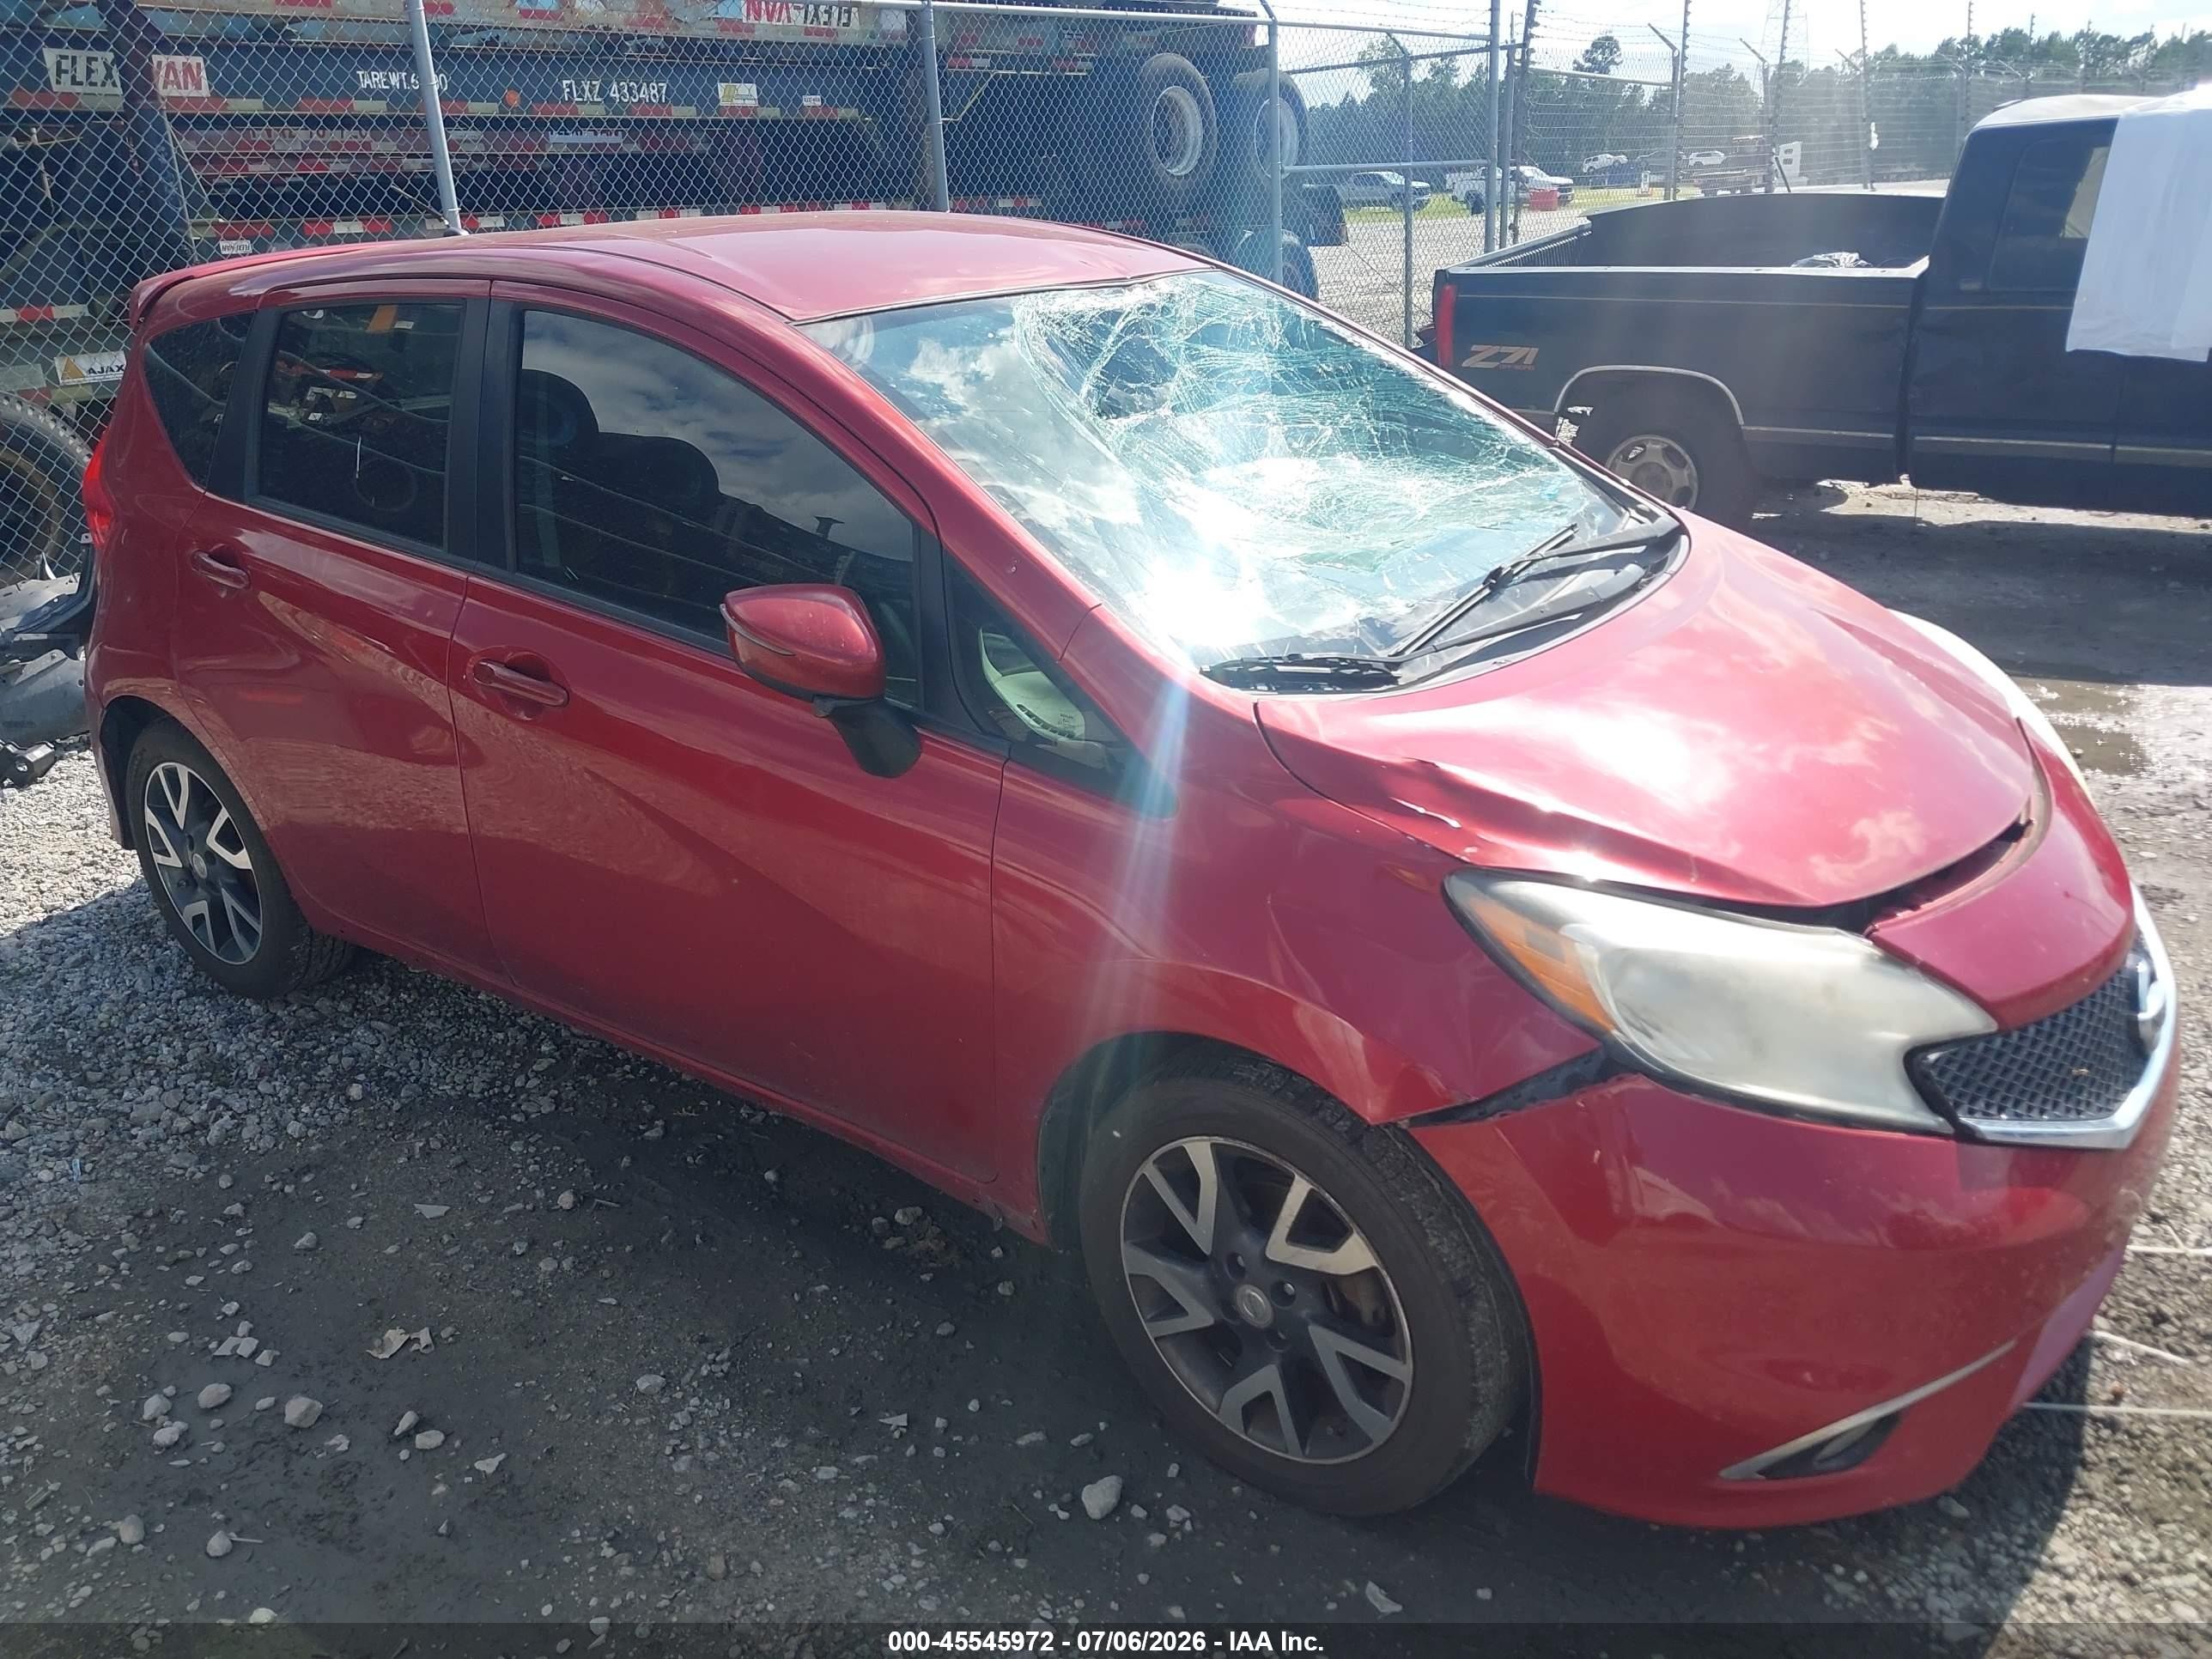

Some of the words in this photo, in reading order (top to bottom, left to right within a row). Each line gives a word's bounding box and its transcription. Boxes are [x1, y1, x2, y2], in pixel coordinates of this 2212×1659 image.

[562, 80, 602, 102] FLXZ
[609, 81, 668, 104] 433487
[1462, 344, 1540, 368] Z71
[88, 364, 125, 375] AJAX
